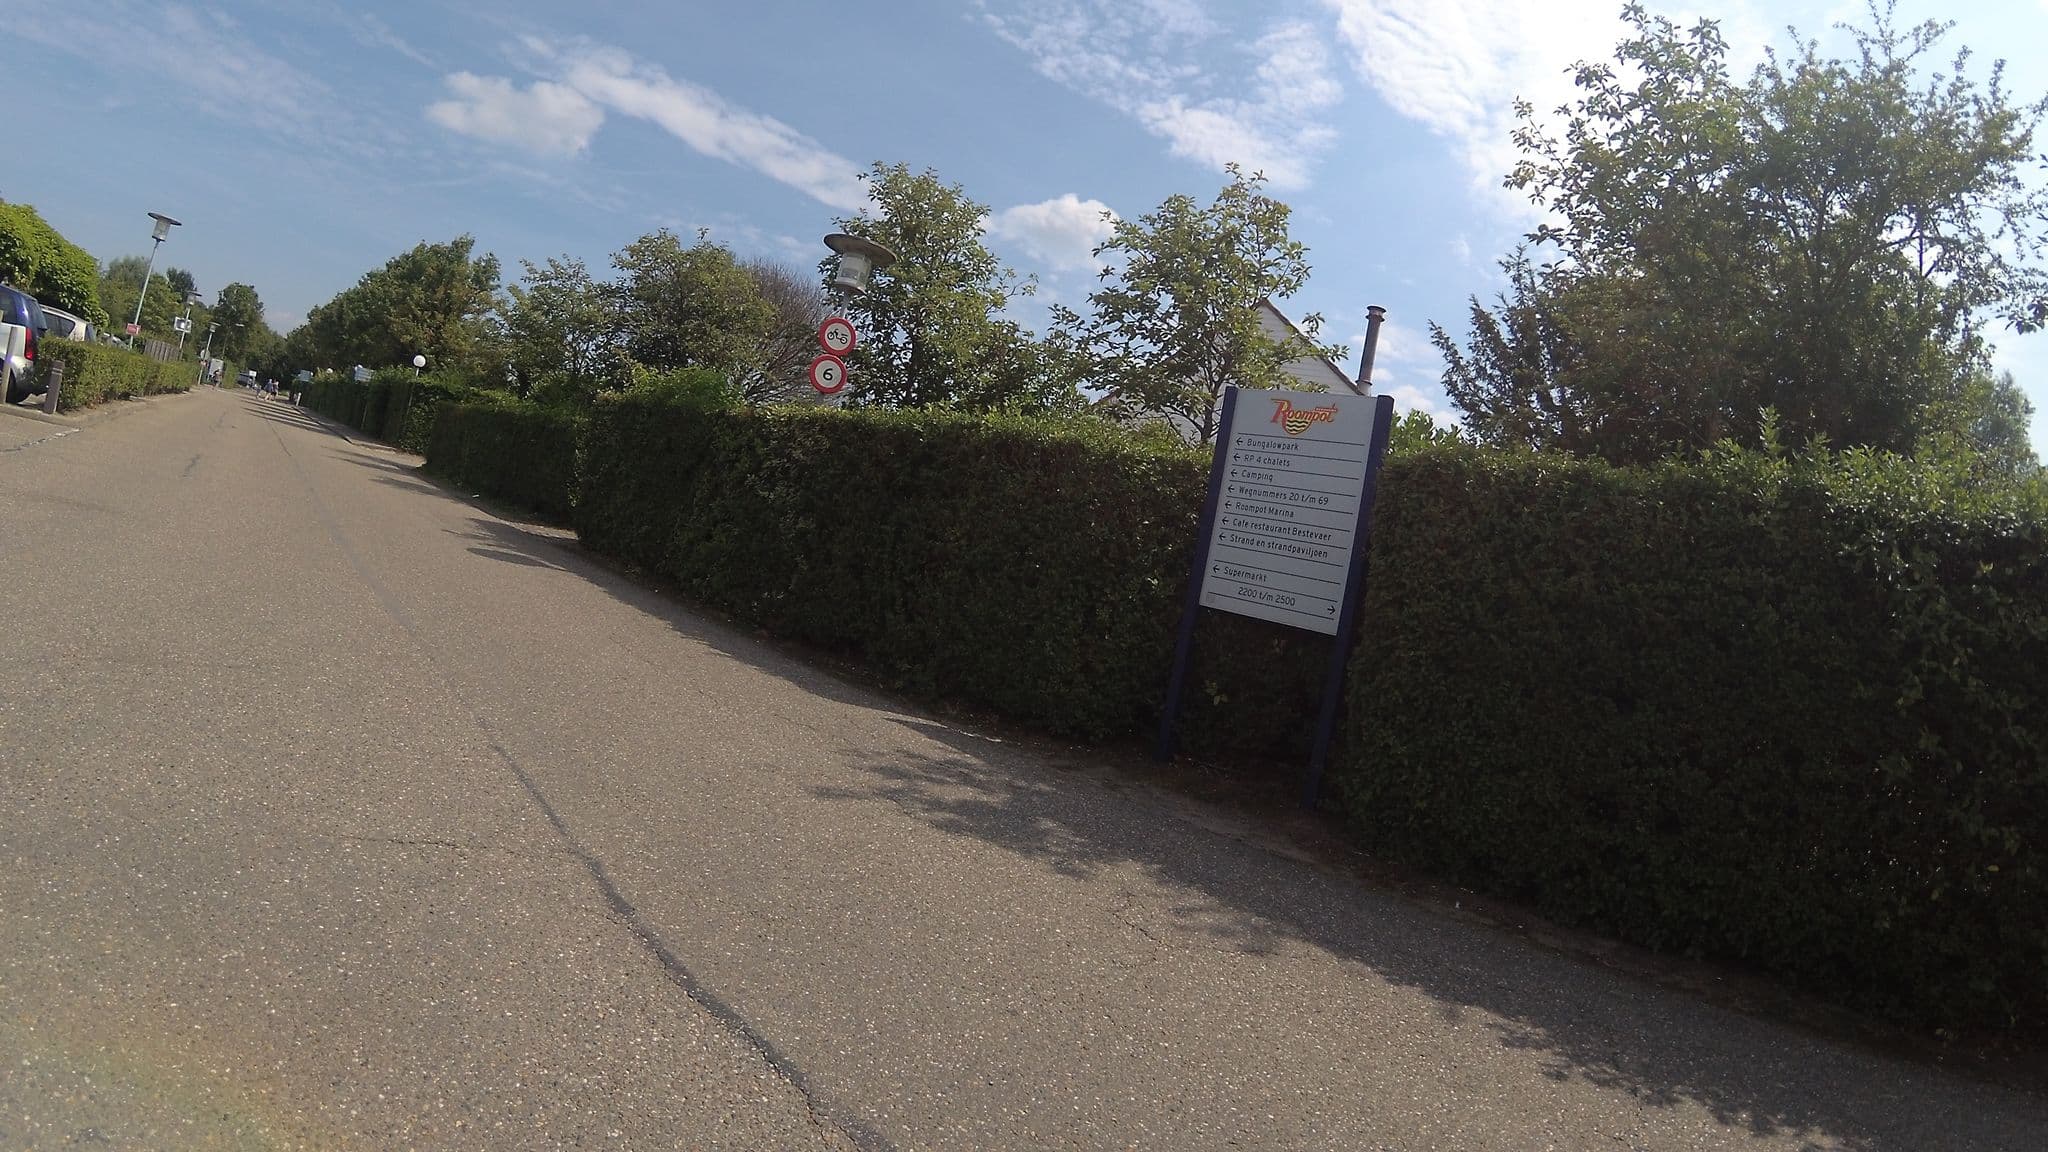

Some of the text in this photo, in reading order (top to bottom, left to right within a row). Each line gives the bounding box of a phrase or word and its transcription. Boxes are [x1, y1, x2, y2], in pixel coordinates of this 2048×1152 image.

[822, 367, 833, 381] 6
[1270, 398, 1339, 428] Roompot
[1246, 438, 1299, 451] Bungalowpark
[1263, 457, 1290, 467] chalets
[1241, 469, 1274, 482] Camping
[1238, 486, 1329, 506] Wegnummers 20 t/m 69
[1235, 502, 1294, 518] Roompot Marina
[1250, 521, 1291, 535] restaurant
[1292, 528, 1332, 541] Bestevaer
[1230, 534, 1328, 559] Strand en strandpaviljoen
[1223, 566, 1267, 582] Supermarkt
[1238, 586, 1296, 607] 2200 t/m 2500
